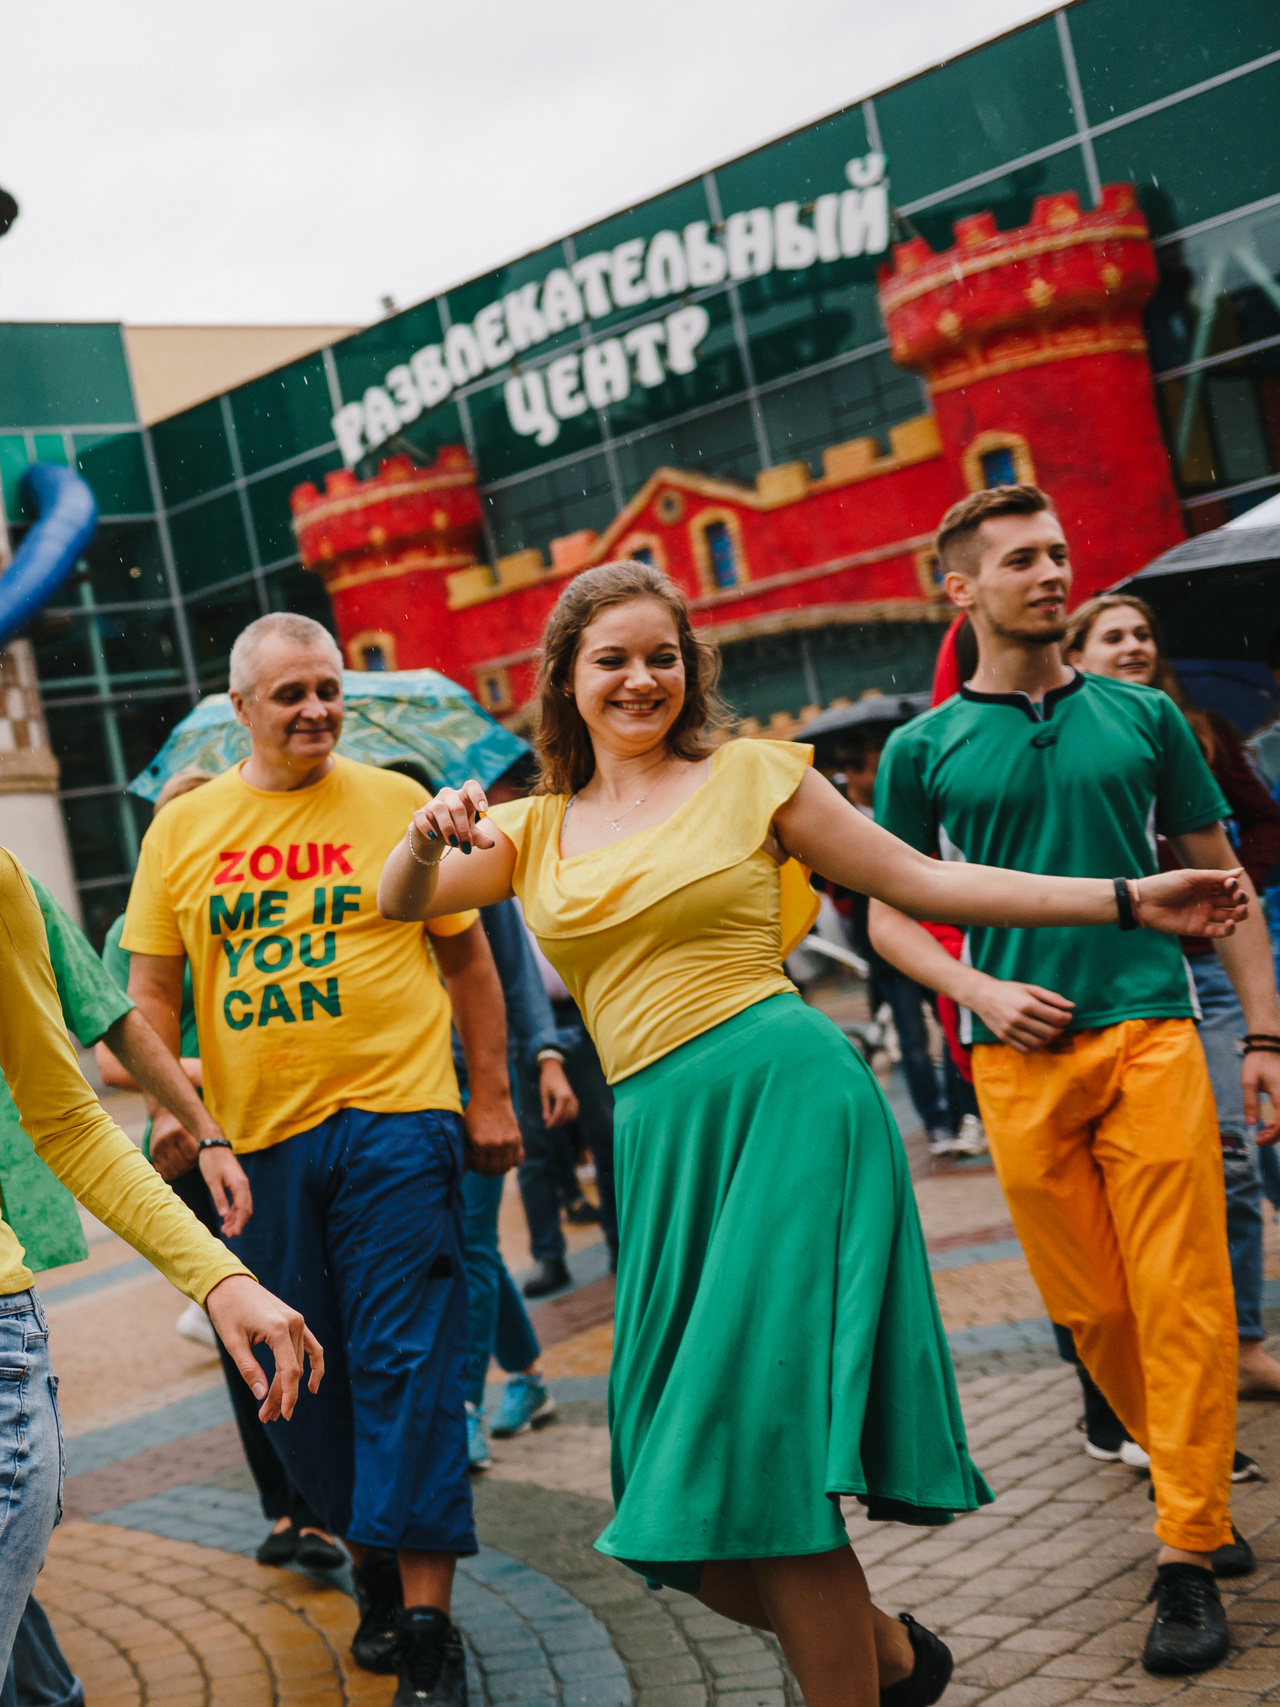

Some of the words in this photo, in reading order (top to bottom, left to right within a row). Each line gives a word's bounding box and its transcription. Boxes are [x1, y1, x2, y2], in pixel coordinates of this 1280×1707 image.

[331, 152, 889, 469] РАЗВЛЕКАТЕЛЬНЫЙ
[504, 305, 709, 446] ЦЕНТР
[213, 843, 354, 885] ZOUK
[209, 890, 288, 935] ME
[312, 886, 361, 924] IF
[223, 931, 336, 977] YOU
[223, 977, 342, 1030] CAN
